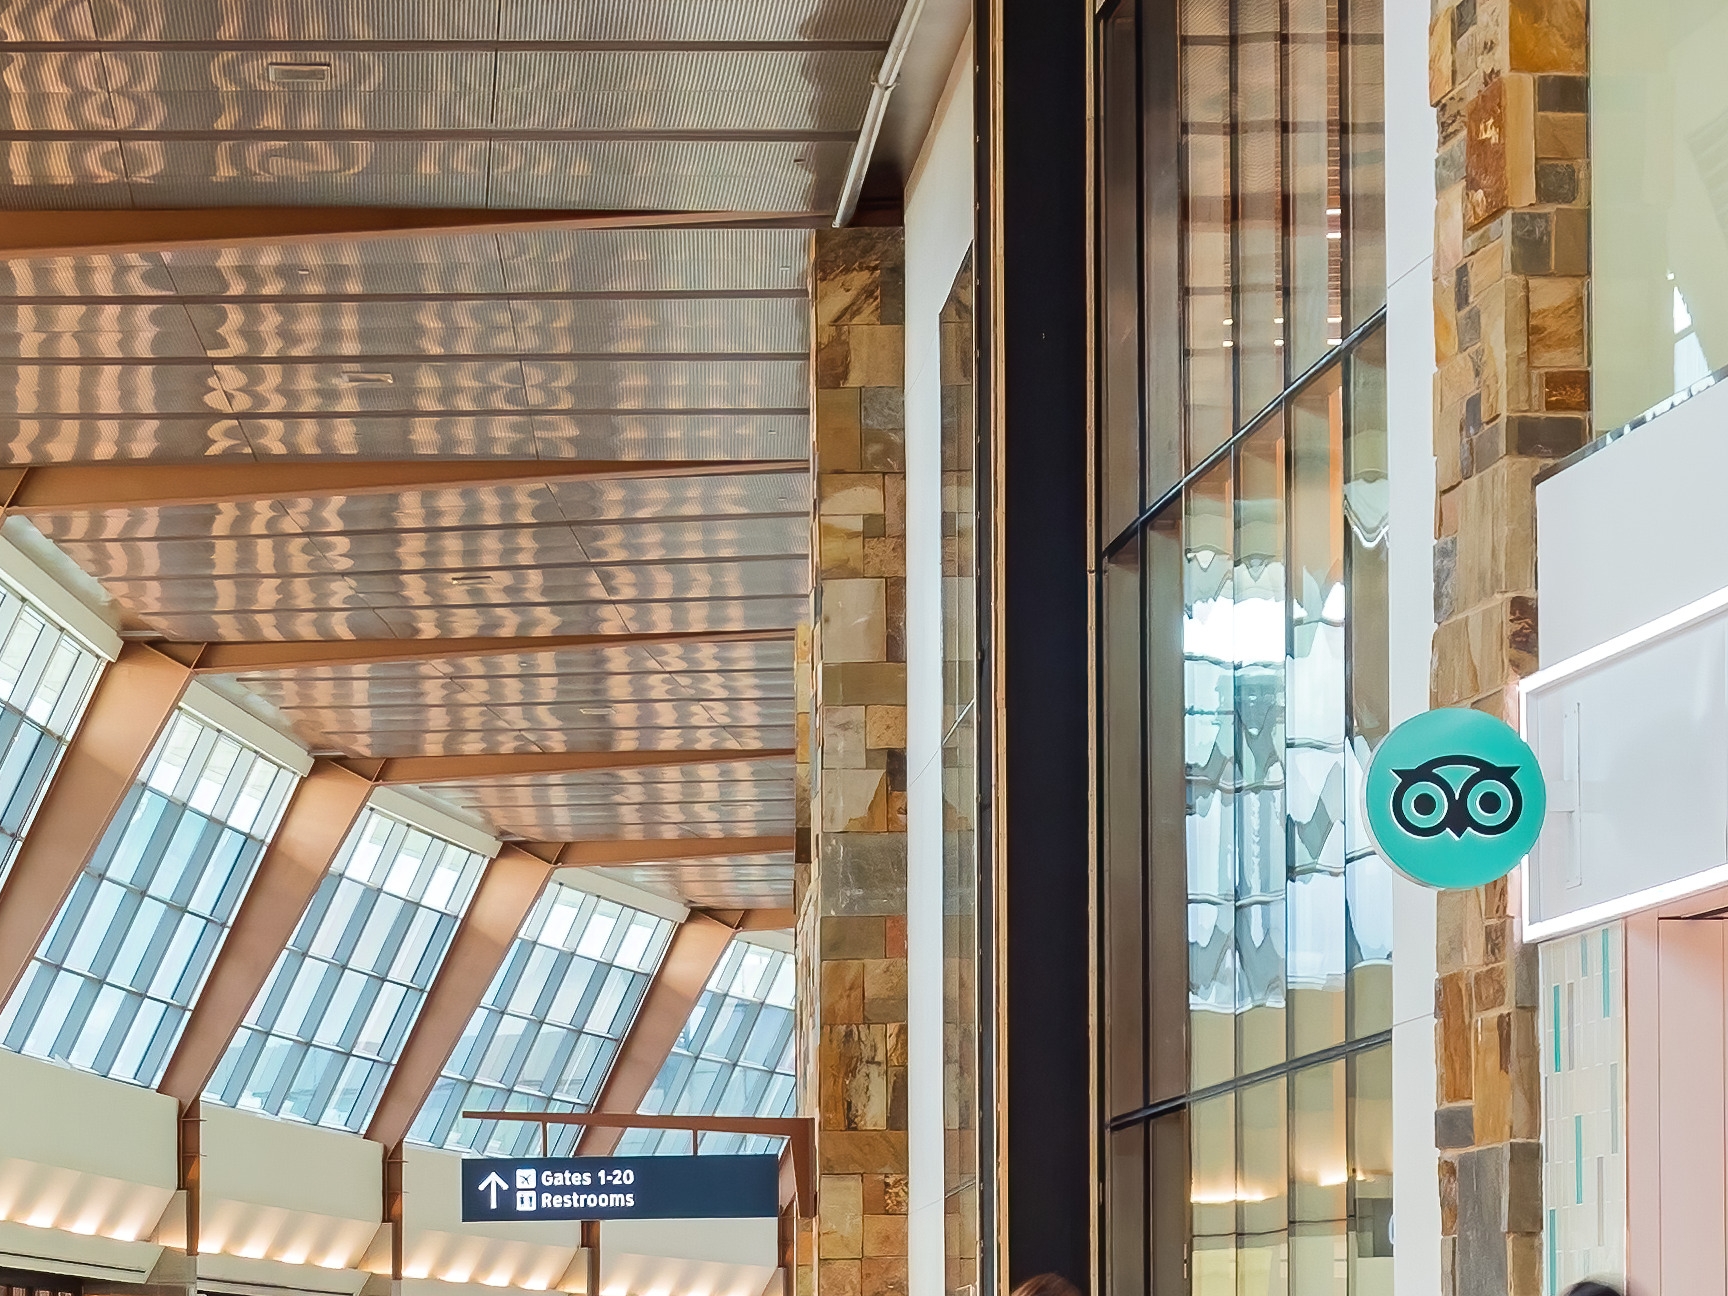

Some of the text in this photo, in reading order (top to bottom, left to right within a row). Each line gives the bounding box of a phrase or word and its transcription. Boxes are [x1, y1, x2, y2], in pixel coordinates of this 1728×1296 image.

[541, 1169, 635, 1187] Gates 1-20
[541, 1192, 635, 1208] Restrooms
